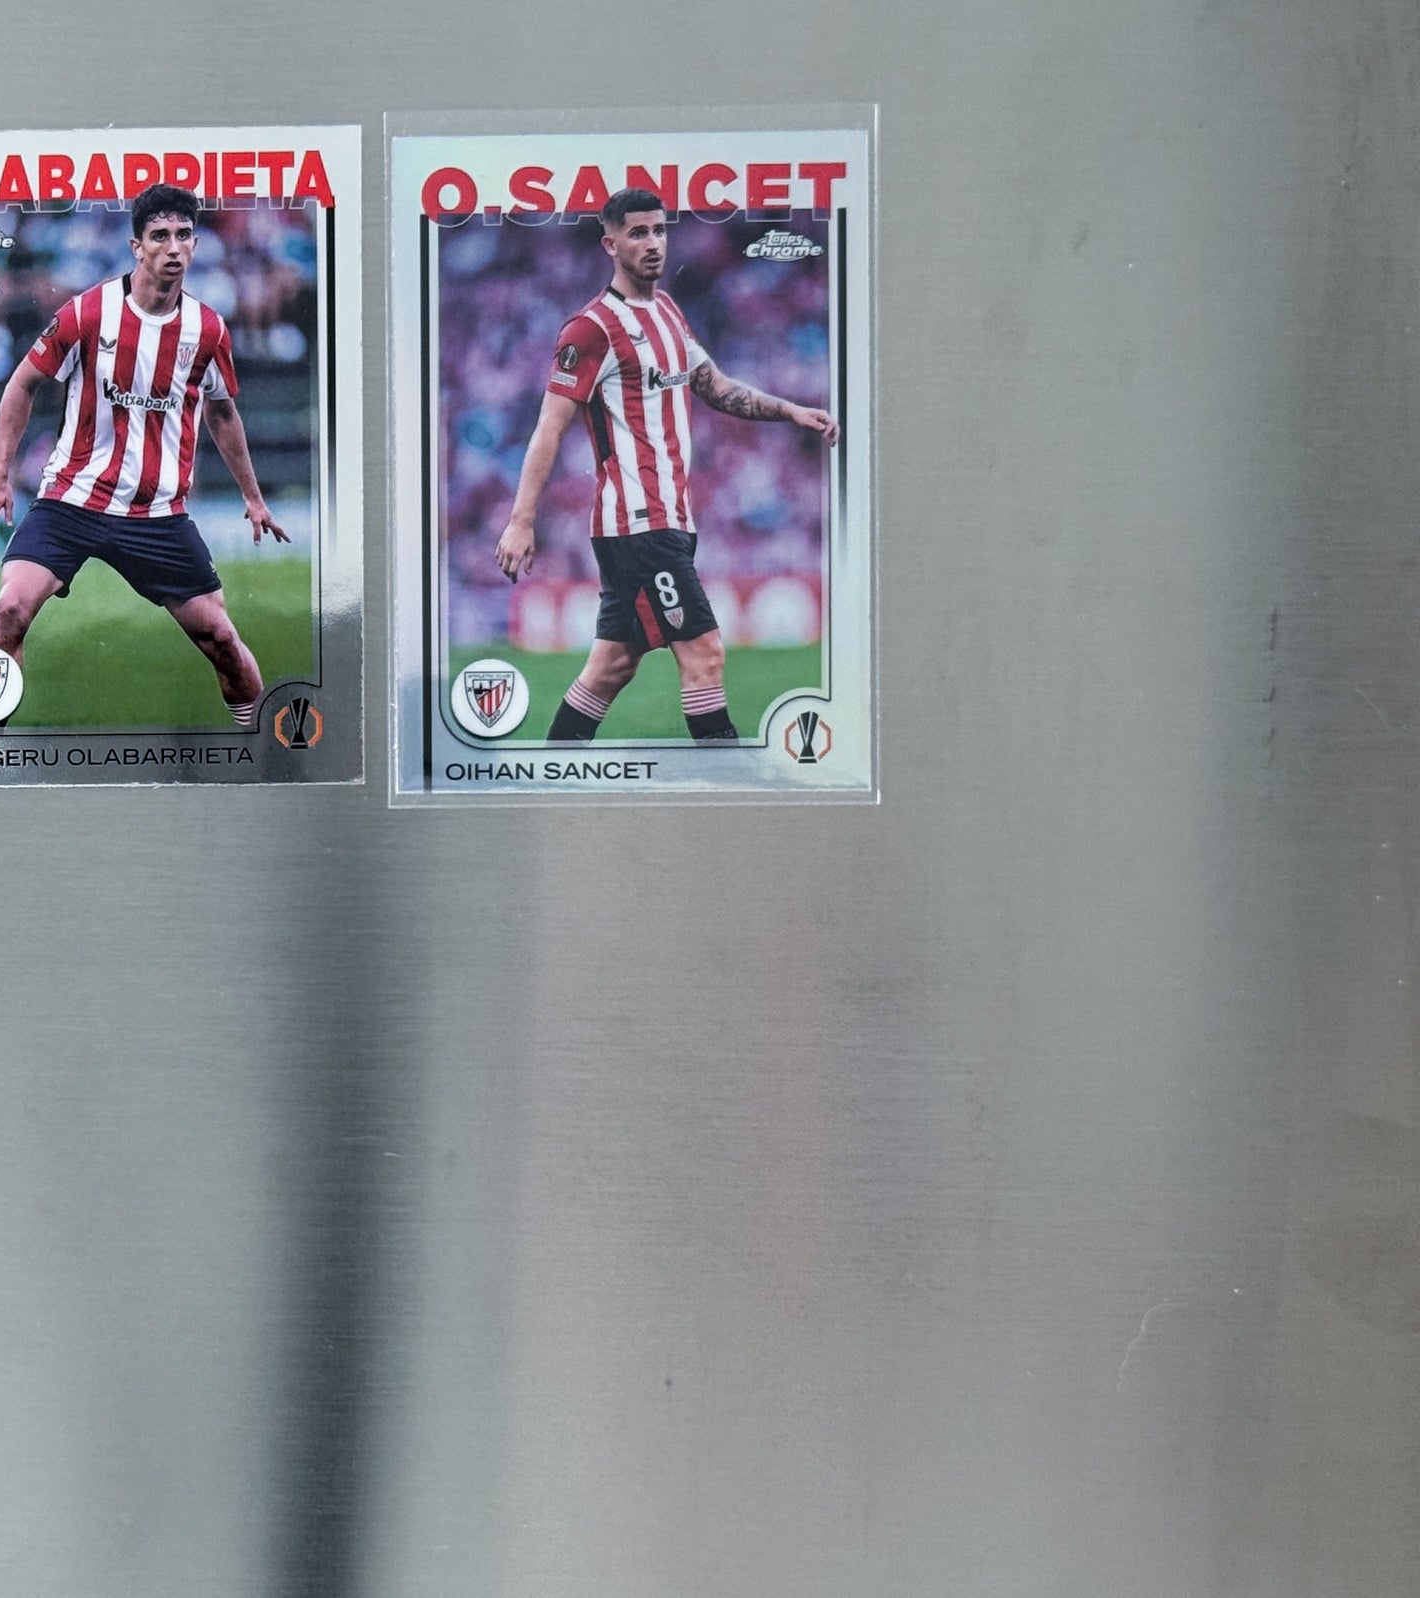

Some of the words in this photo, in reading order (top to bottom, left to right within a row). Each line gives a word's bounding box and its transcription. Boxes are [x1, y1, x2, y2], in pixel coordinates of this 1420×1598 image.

[745, 243, 823, 258] Chrome
[103, 377, 178, 410] Kutxabank
[654, 570, 680, 608] 8
[67, 746, 255, 767] OLABARRIETA
[445, 762, 535, 781] OIHAN
[543, 761, 658, 780] SANCET
